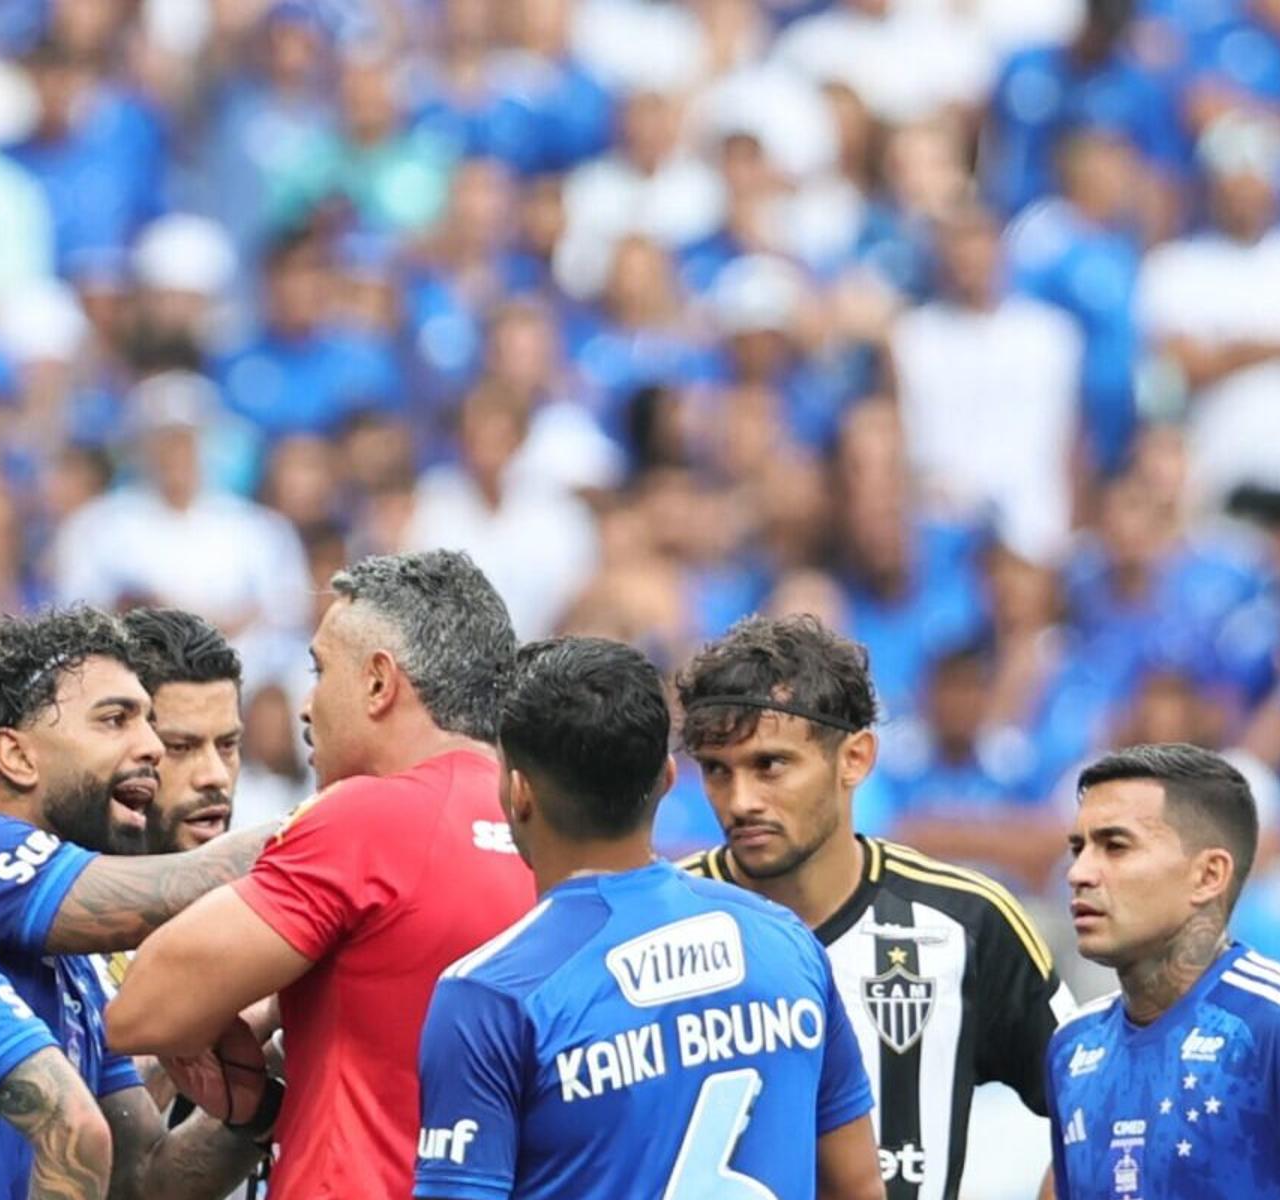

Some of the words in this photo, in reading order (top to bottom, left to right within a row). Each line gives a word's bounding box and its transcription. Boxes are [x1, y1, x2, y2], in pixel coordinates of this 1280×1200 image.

[472, 820, 518, 854] SE
[622, 941, 732, 990] Vilma
[870, 983, 928, 998] CAM
[556, 1022, 666, 1102] KAIKI
[676, 997, 823, 1067] BRUNO
